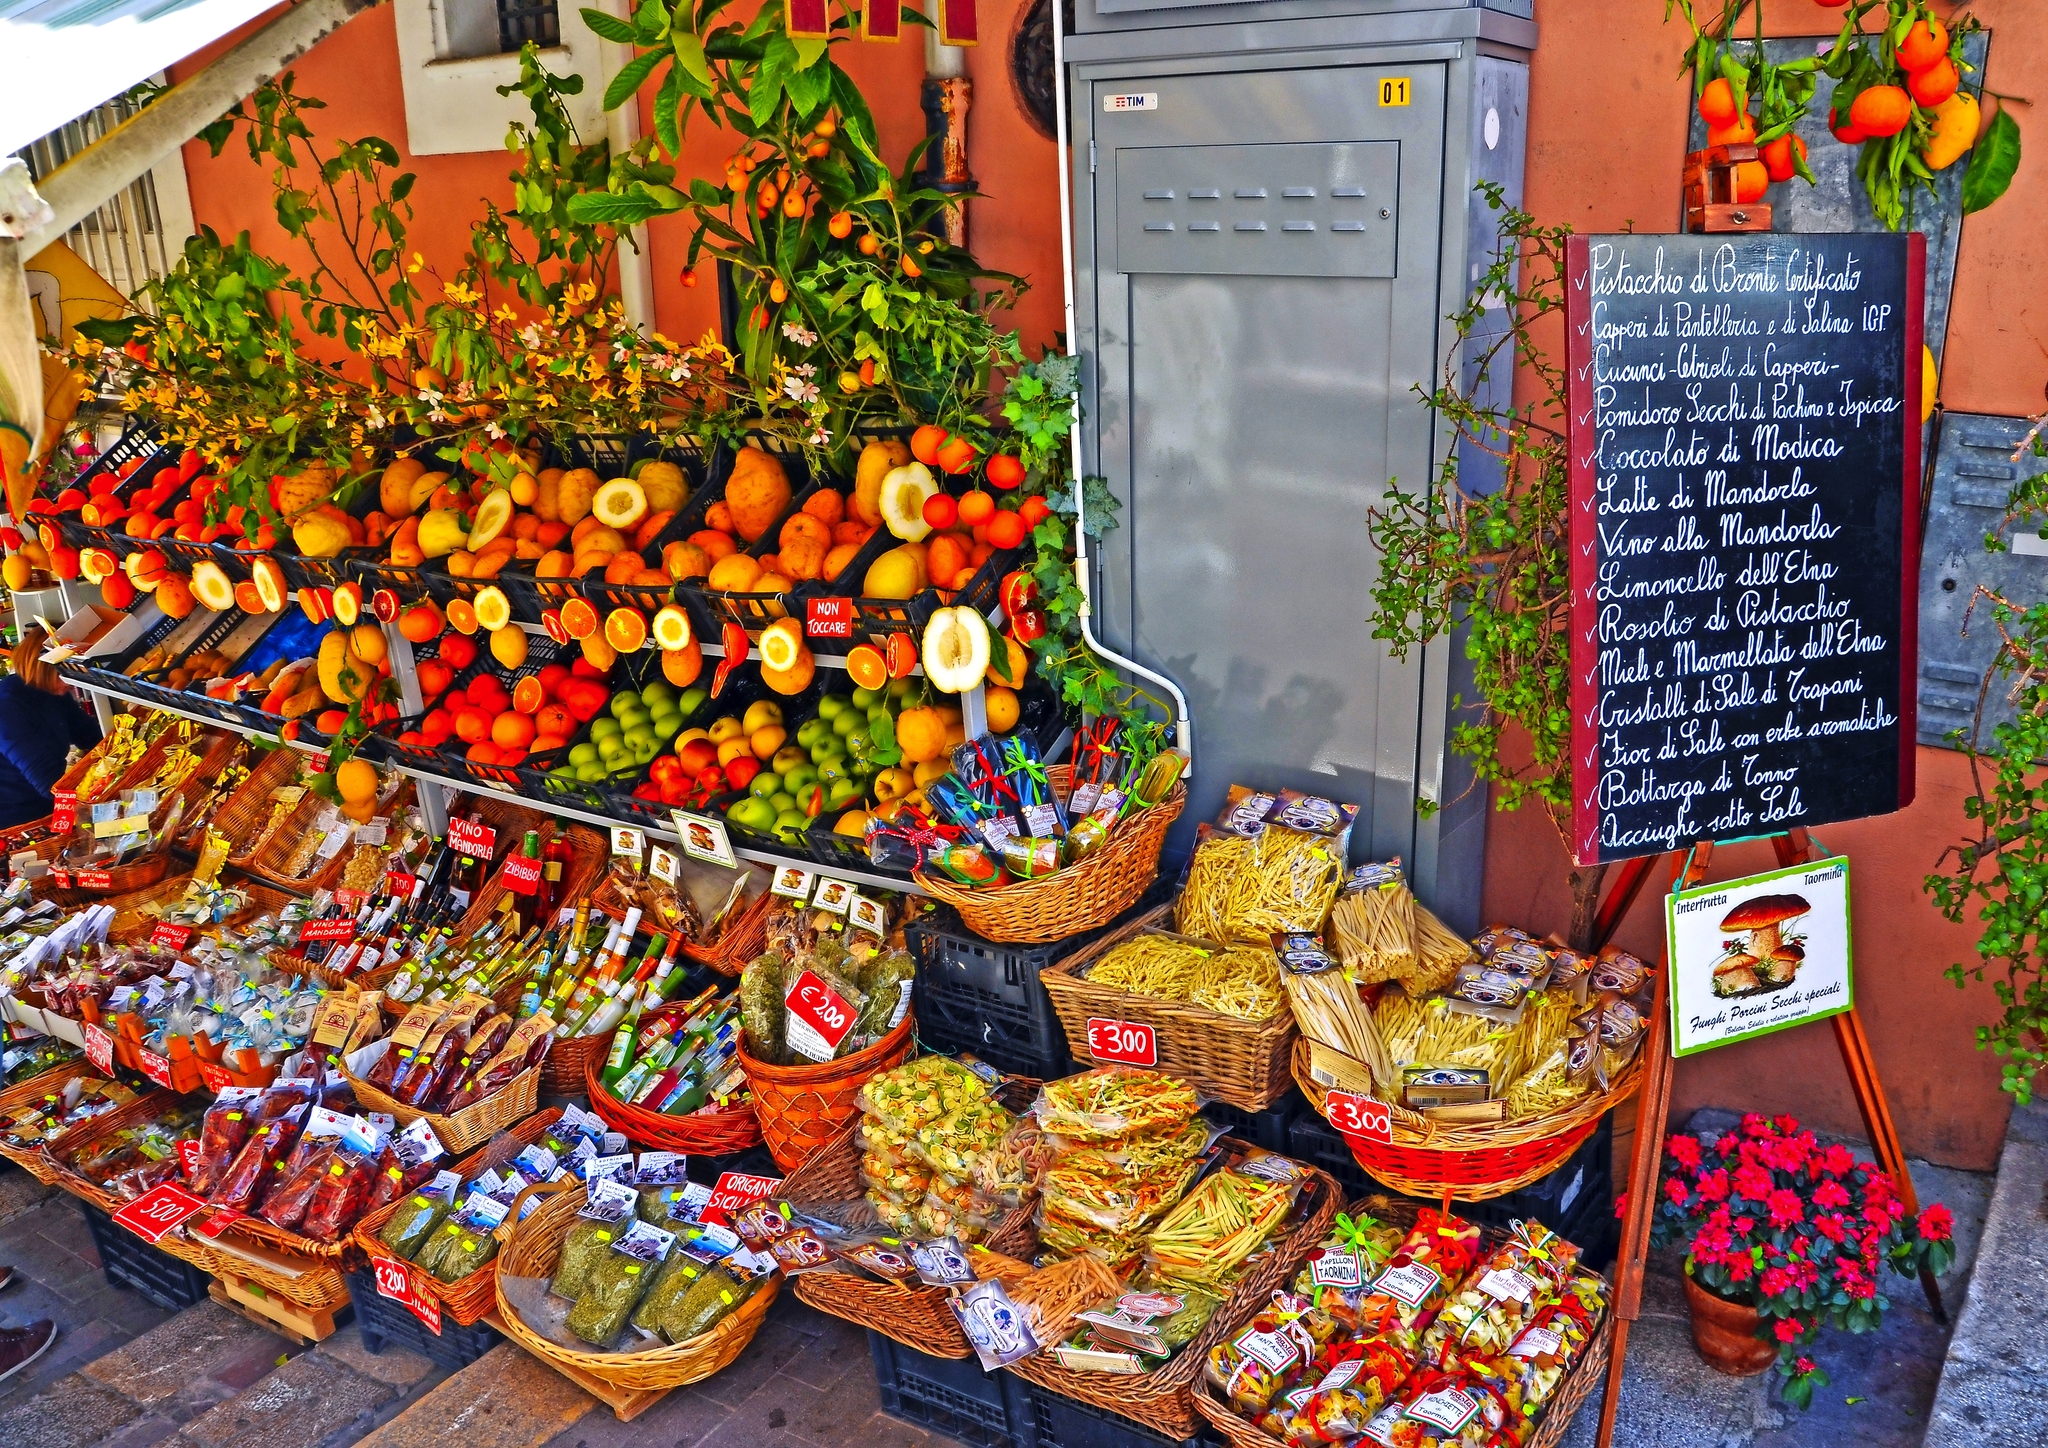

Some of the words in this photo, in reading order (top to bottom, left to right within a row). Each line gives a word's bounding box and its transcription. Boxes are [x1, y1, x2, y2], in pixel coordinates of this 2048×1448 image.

[1126, 96, 1144, 107] TIM
[1591, 243, 1684, 297] Pistacchio
[1690, 249, 1709, 294] di
[1713, 243, 1780, 293] Bronte
[1785, 249, 1861, 301] Certificato
[1591, 301, 1649, 350] Capperi
[1653, 304, 1669, 337] di
[1674, 302, 1760, 338] Pantelleria
[1767, 321, 1776, 334] e
[1781, 300, 1797, 334] di
[1802, 298, 1853, 334] Salina
[1738, 347, 1757, 376] di
[1595, 386, 1682, 428] Pomidoro
[1686, 382, 1747, 422] Secchi
[1750, 383, 1766, 420] di
[1771, 382, 1823, 420] Pachino
[1827, 402, 1835, 416] e
[1597, 427, 1709, 470] Cioccolato
[1717, 427, 1740, 464] di
[1752, 424, 1844, 462] Modica
[1597, 472, 1660, 516] Latte
[1669, 471, 1694, 510] di
[1705, 467, 1817, 507] Mandorla
[1598, 518, 1657, 557] Vino
[1660, 515, 1710, 553] alla
[1721, 503, 1841, 546] Mandorla
[1597, 556, 1727, 601] Limoncello
[1736, 549, 1839, 587] dell'Etna
[817, 602, 839, 616] NON
[1598, 600, 1696, 643] Rosolio
[1705, 597, 1729, 632] di
[1737, 584, 1850, 629] Pistacchio
[807, 619, 847, 634] TOCCARE
[1599, 646, 1651, 686] Miele
[1654, 661, 1664, 678] e
[1674, 630, 1796, 677] Marmellata
[1800, 619, 1886, 660] dell'Etna
[1598, 682, 1688, 728] Cristalli
[1692, 681, 1712, 713] di
[1712, 674, 1757, 709] Sale
[1760, 671, 1778, 705] di
[1787, 667, 1862, 711] Trapani
[1602, 730, 1650, 768] Fior
[1658, 727, 1678, 768] di
[1680, 718, 1725, 757] Sale
[1731, 734, 1760, 749] con
[1766, 711, 1802, 741] erbe
[1808, 698, 1897, 737] aromatiche
[1598, 767, 1706, 812] Bottarga
[1710, 760, 1732, 791] di
[1741, 754, 1798, 786] Tonno
[456, 820, 482, 838] VINO
[1599, 810, 1702, 849] Acciughe
[1707, 798, 1753, 831] sotto
[1760, 785, 1808, 822] Sale
[449, 835, 494, 861] MANDORLA
[1676, 894, 1728, 915] Interfrutta
[1804, 869, 1843, 886] Taormina
[305, 928, 351, 937] MANDORLA
[801, 986, 820, 1003] €
[1690, 1012, 1726, 1034] Funghi
[1731, 1002, 1768, 1021] Porcini
[1771, 992, 1803, 1010] Secchi
[1804, 981, 1841, 1002] speciali
[1318, 1266, 1357, 1281] TAORMINA
[1320, 1257, 1354, 1265] PAPILLON
[410, 1277, 438, 1310] RIGANO
[1383, 1280, 1414, 1299] Taormina
[1390, 1270, 1425, 1290] FISCHIETTI
[1246, 1342, 1276, 1367] Taormina
[1253, 1334, 1285, 1360] FANTASIA
[1418, 1406, 1452, 1426] Taormina
